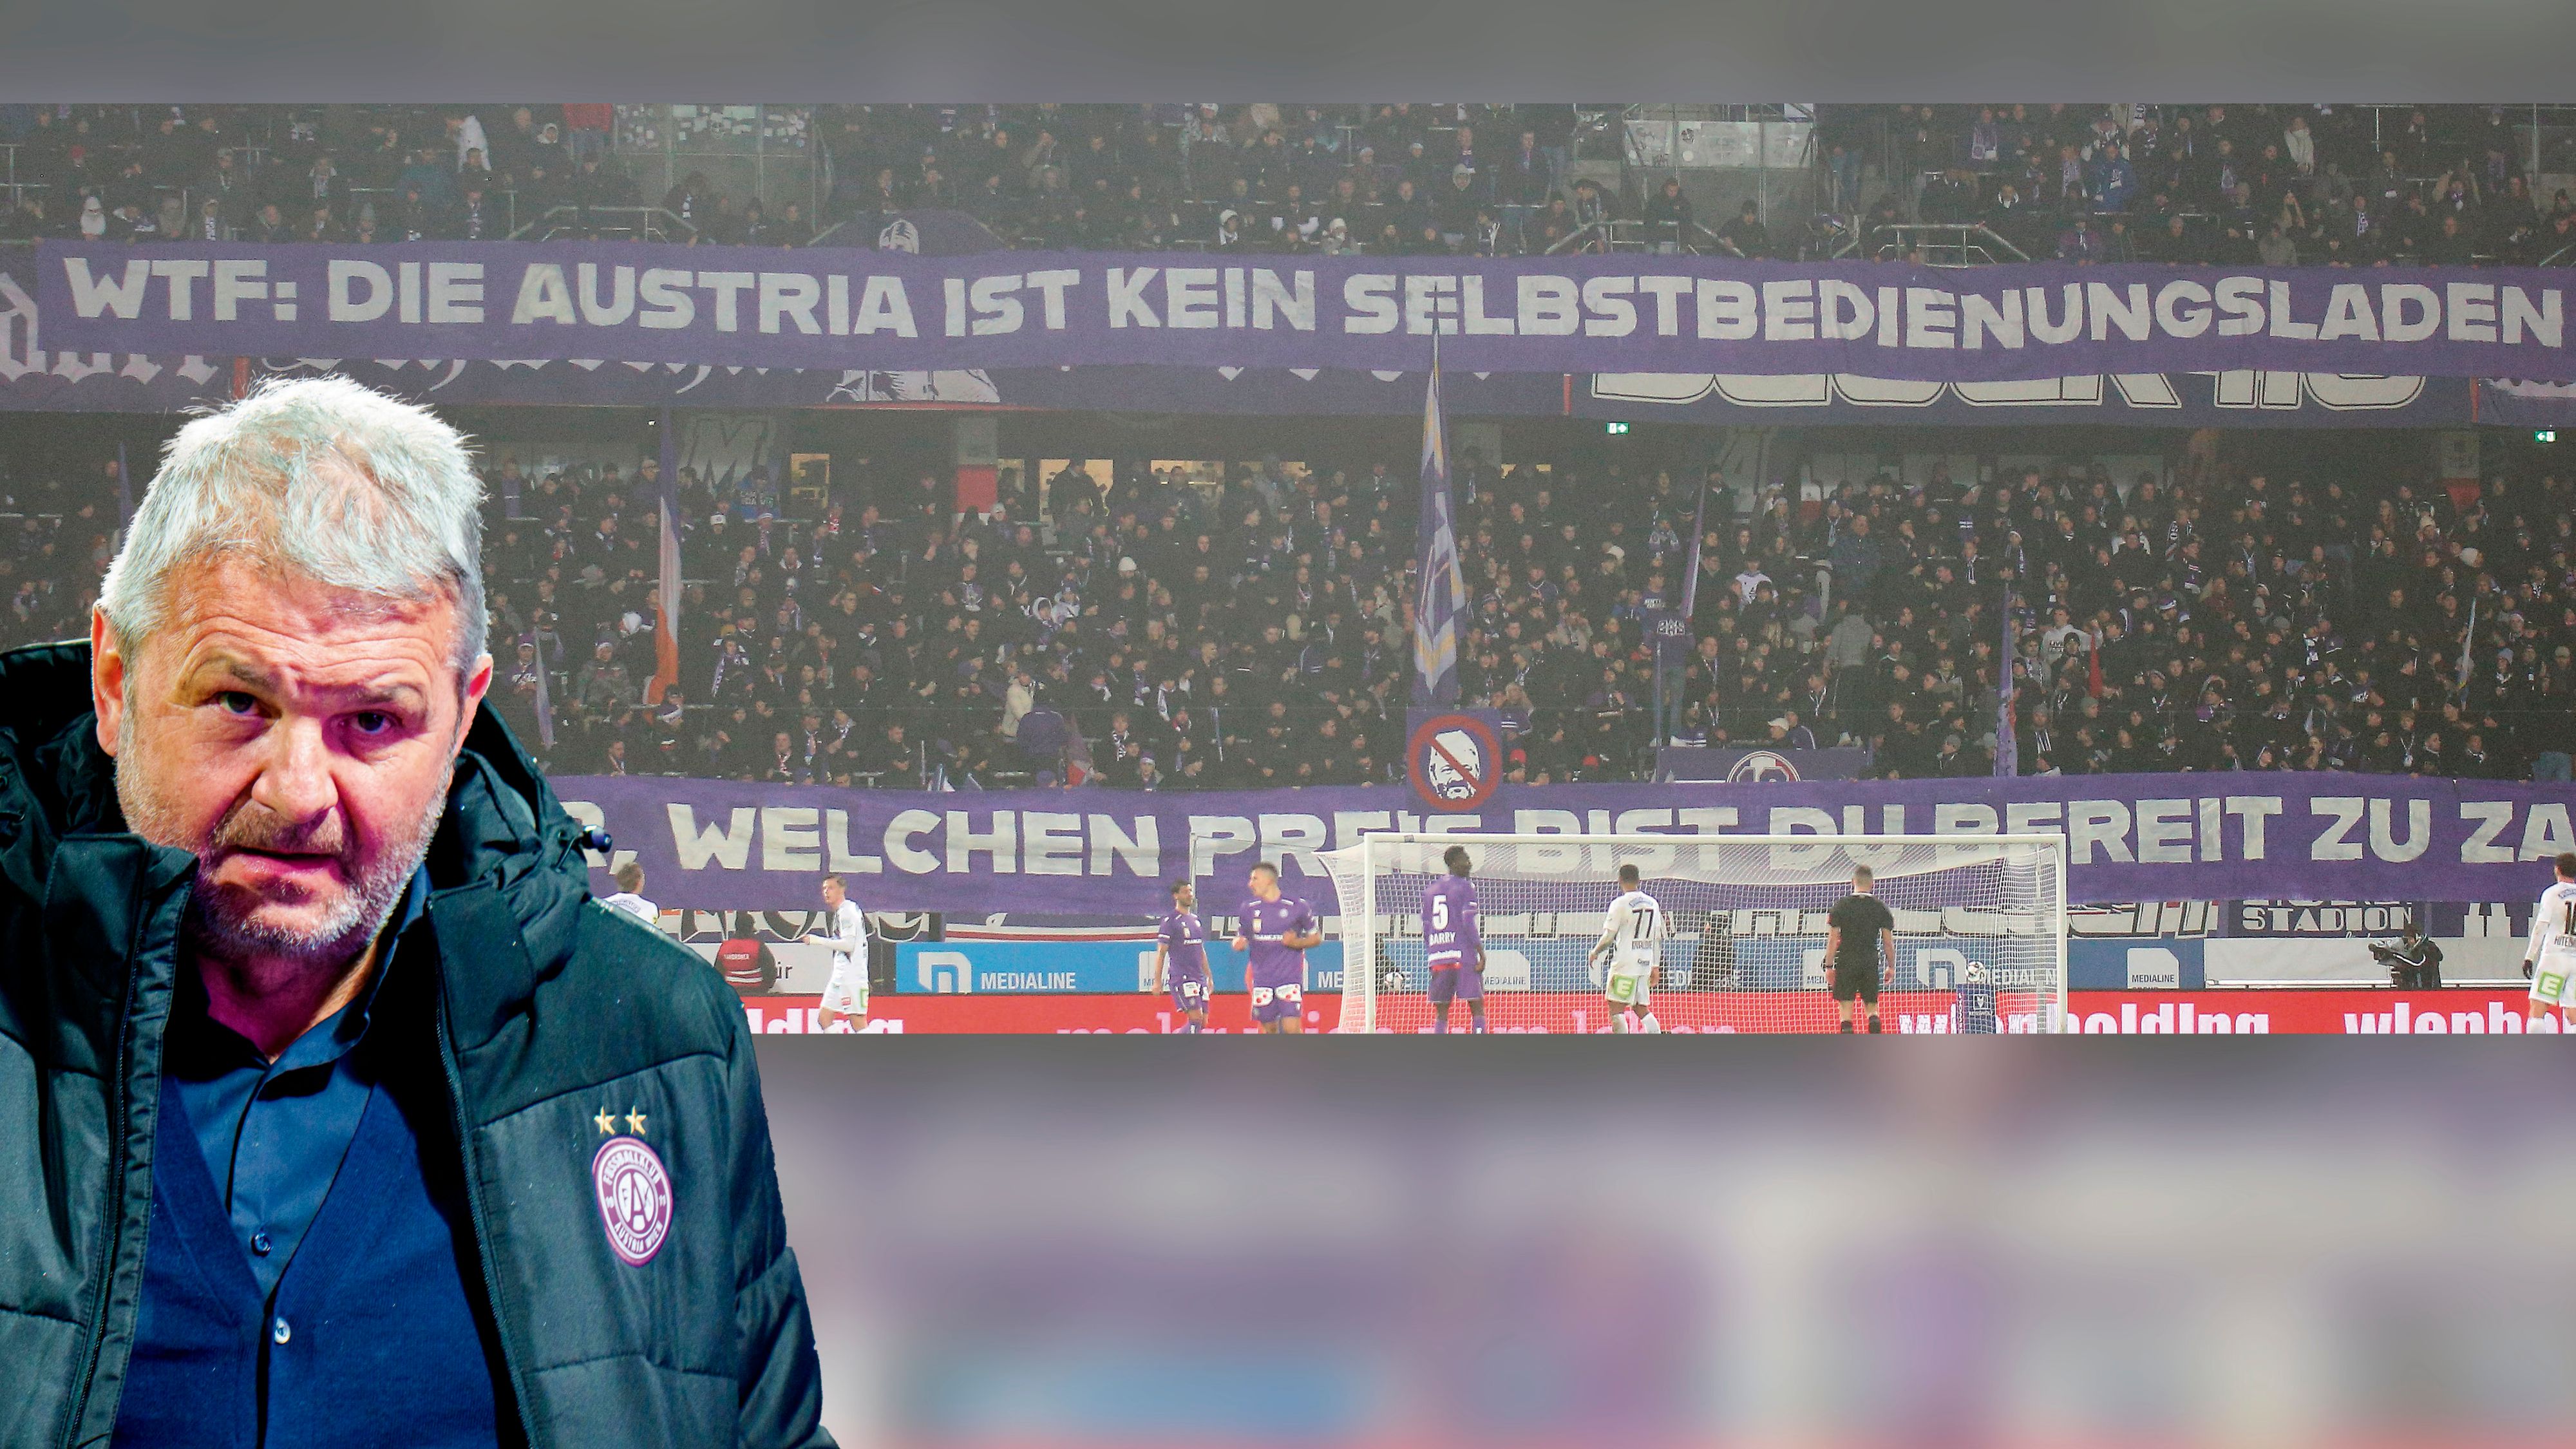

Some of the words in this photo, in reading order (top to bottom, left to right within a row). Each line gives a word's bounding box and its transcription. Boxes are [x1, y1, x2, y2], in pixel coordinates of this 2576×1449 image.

[64, 257, 298, 321] WTF:
[328, 260, 485, 324] DIE
[511, 263, 918, 337] AUSTRIA
[943, 269, 1081, 337] IST
[1106, 267, 1316, 331] KEIN
[1343, 273, 2564, 349] SELBSTBEDIENUNGSLADEN
[667, 803, 1159, 876] WELCHEN
[1514, 807, 1739, 873] BIST
[1769, 804, 1906, 871] DU
[1935, 796, 2282, 867] BEREIT
[2310, 797, 2431, 863] ZU
[2460, 797, 2576, 863] ZA
[1433, 895, 1449, 931] 5
[1632, 908, 1654, 938] 77
[2242, 906, 2412, 932] STADION
[1429, 932, 1456, 946] BARRY
[981, 972, 1076, 990] MEDIALINE
[1484, 976, 1526, 985] MEDIALINE
[2132, 974, 2175, 983] MEDIALINE
[603, 1150, 661, 1186] FUSSBALLKLUB
[614, 1222, 645, 1253] AUSTRIA
[645, 1219, 663, 1249] WIEN
